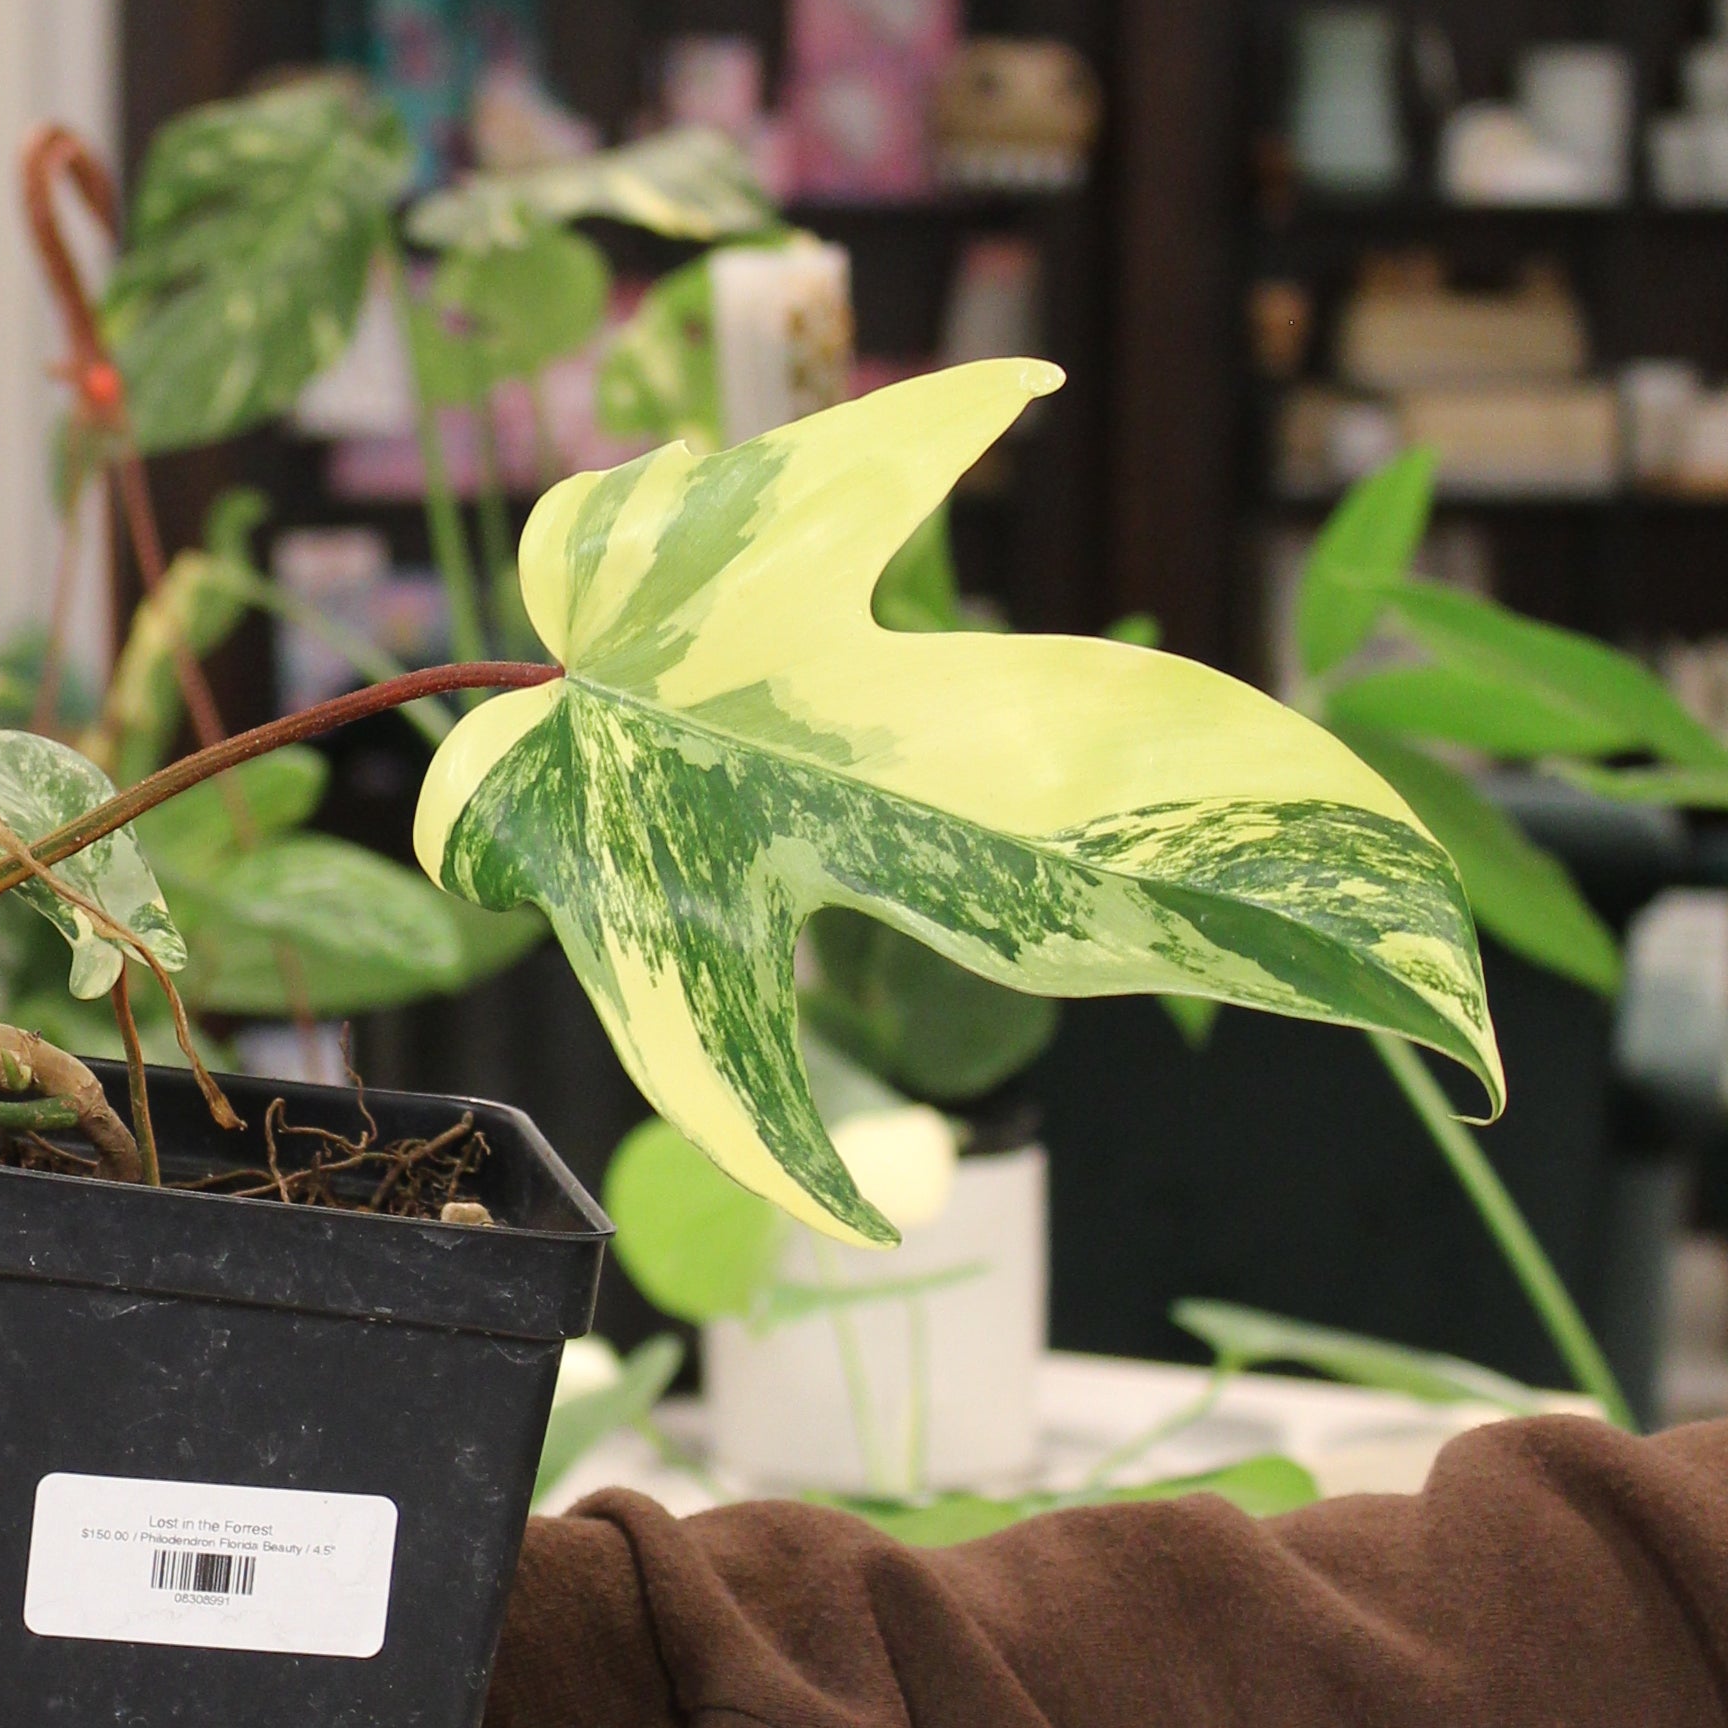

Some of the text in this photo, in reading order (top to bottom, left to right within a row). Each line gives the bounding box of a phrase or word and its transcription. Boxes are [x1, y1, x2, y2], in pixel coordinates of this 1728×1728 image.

[148, 1515, 274, 1536] Lost in the Forrest
[140, 1532, 216, 1548] Philodendron
[219, 1537, 259, 1551] Florida
[262, 1540, 303, 1556] Beauty
